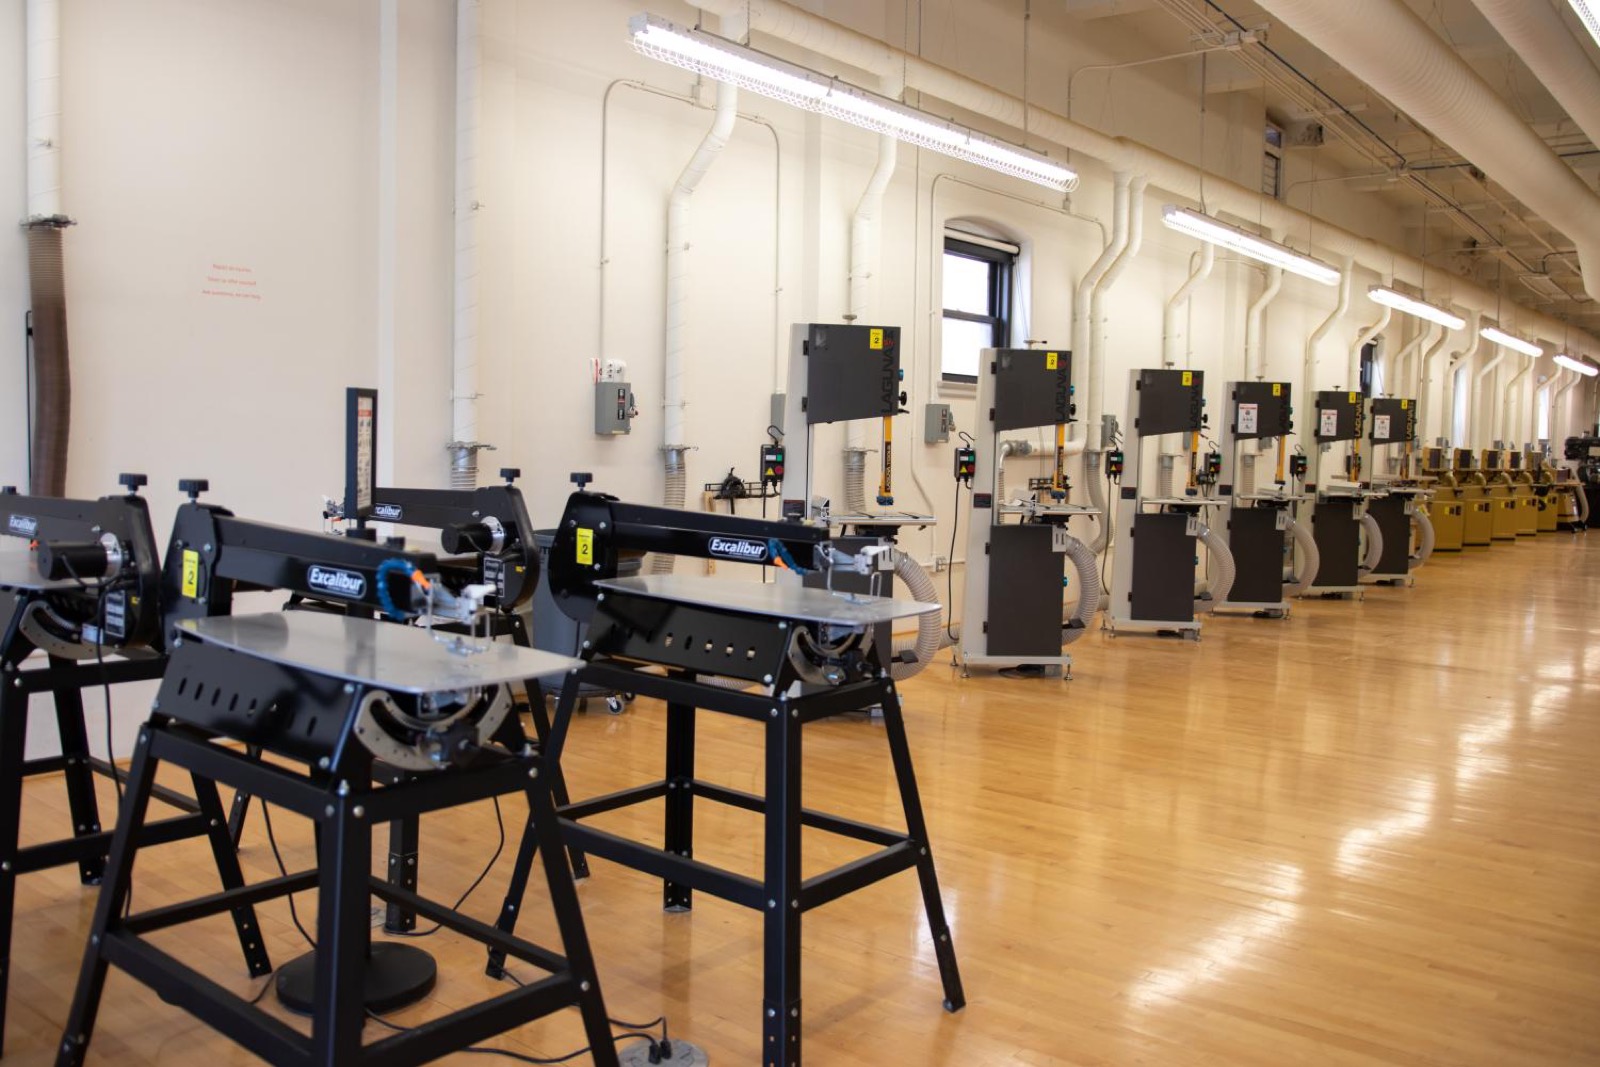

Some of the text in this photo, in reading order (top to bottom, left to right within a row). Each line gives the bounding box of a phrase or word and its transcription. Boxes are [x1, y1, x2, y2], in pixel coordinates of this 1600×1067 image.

[882, 347, 894, 413] LAGUNA
[375, 505, 401, 517] calibur
[582, 543, 588, 555] 2
[711, 538, 765, 555] Excalibur
[188, 570, 195, 585] 2
[310, 568, 363, 591] Excalibur
